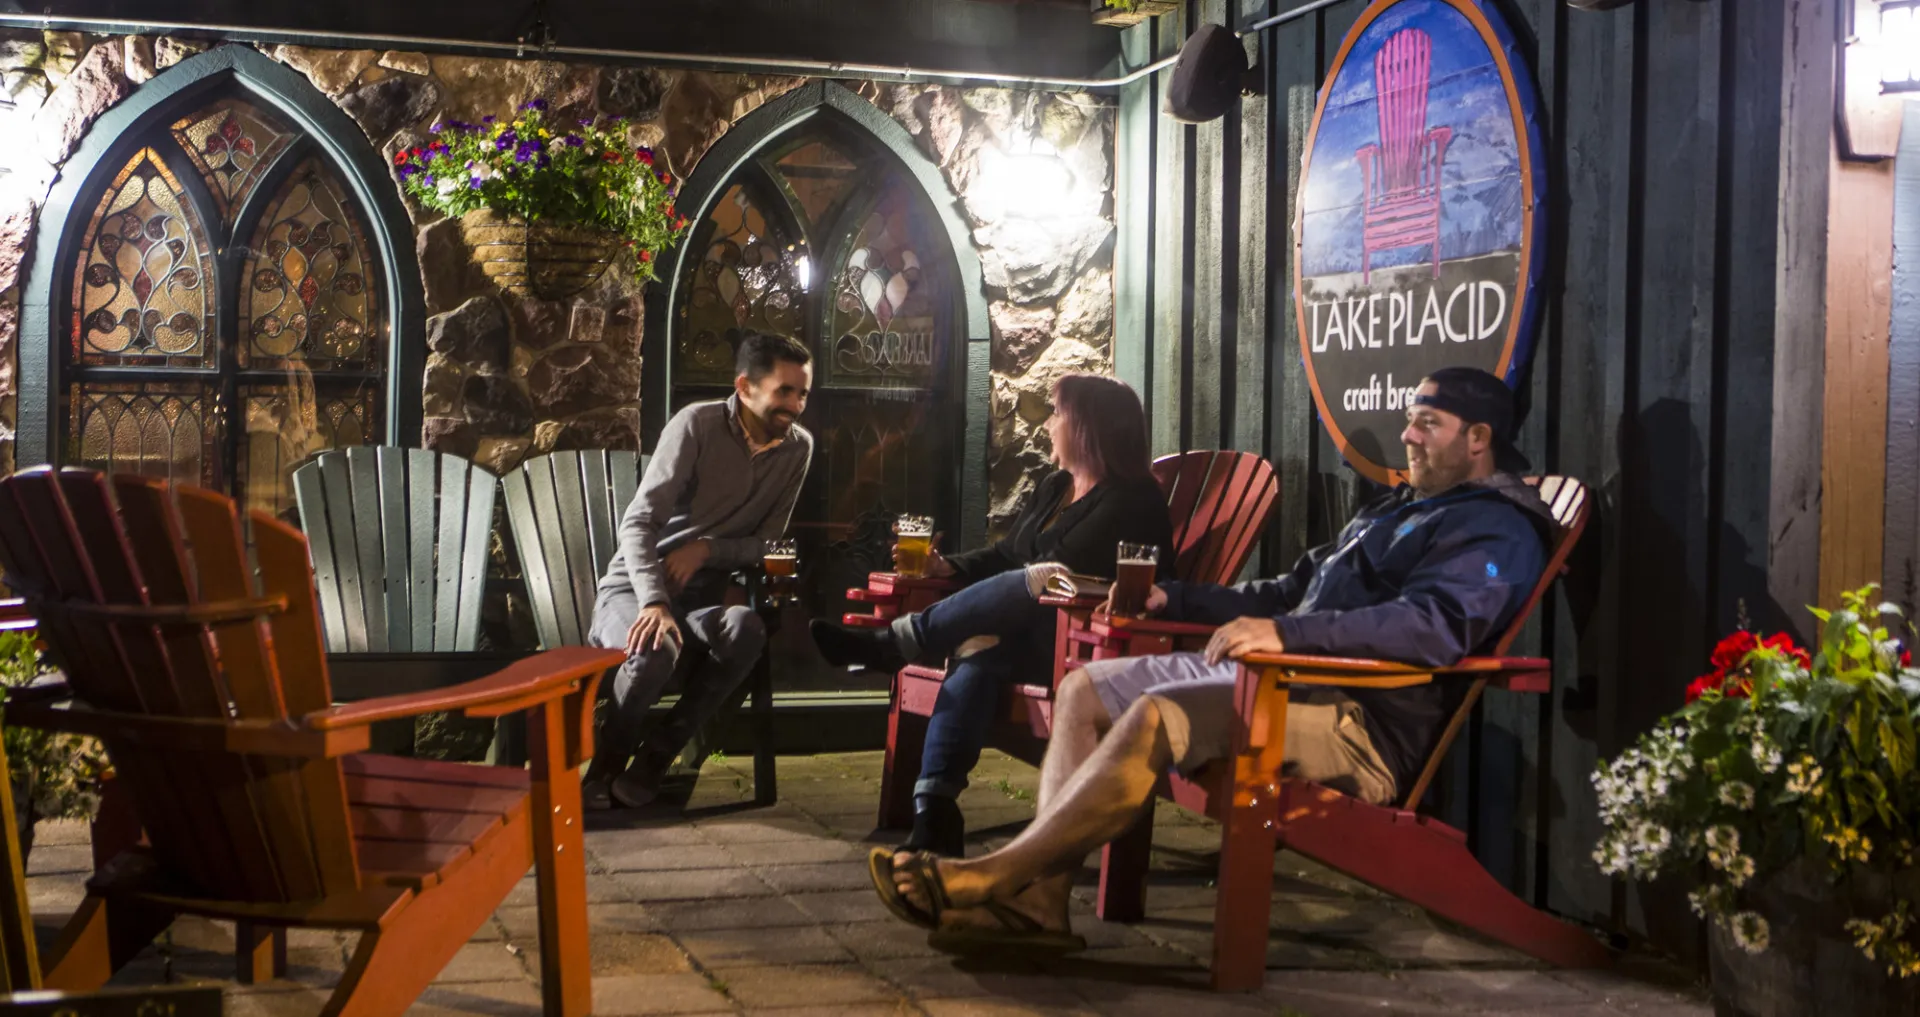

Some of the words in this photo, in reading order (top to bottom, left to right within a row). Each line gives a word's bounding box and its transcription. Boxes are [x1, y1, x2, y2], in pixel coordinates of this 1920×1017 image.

[1312, 293, 1383, 353] LAKE
[1388, 281, 1506, 347] PLACID
[1343, 373, 1382, 411] craft
[1386, 373, 1417, 410] bre
